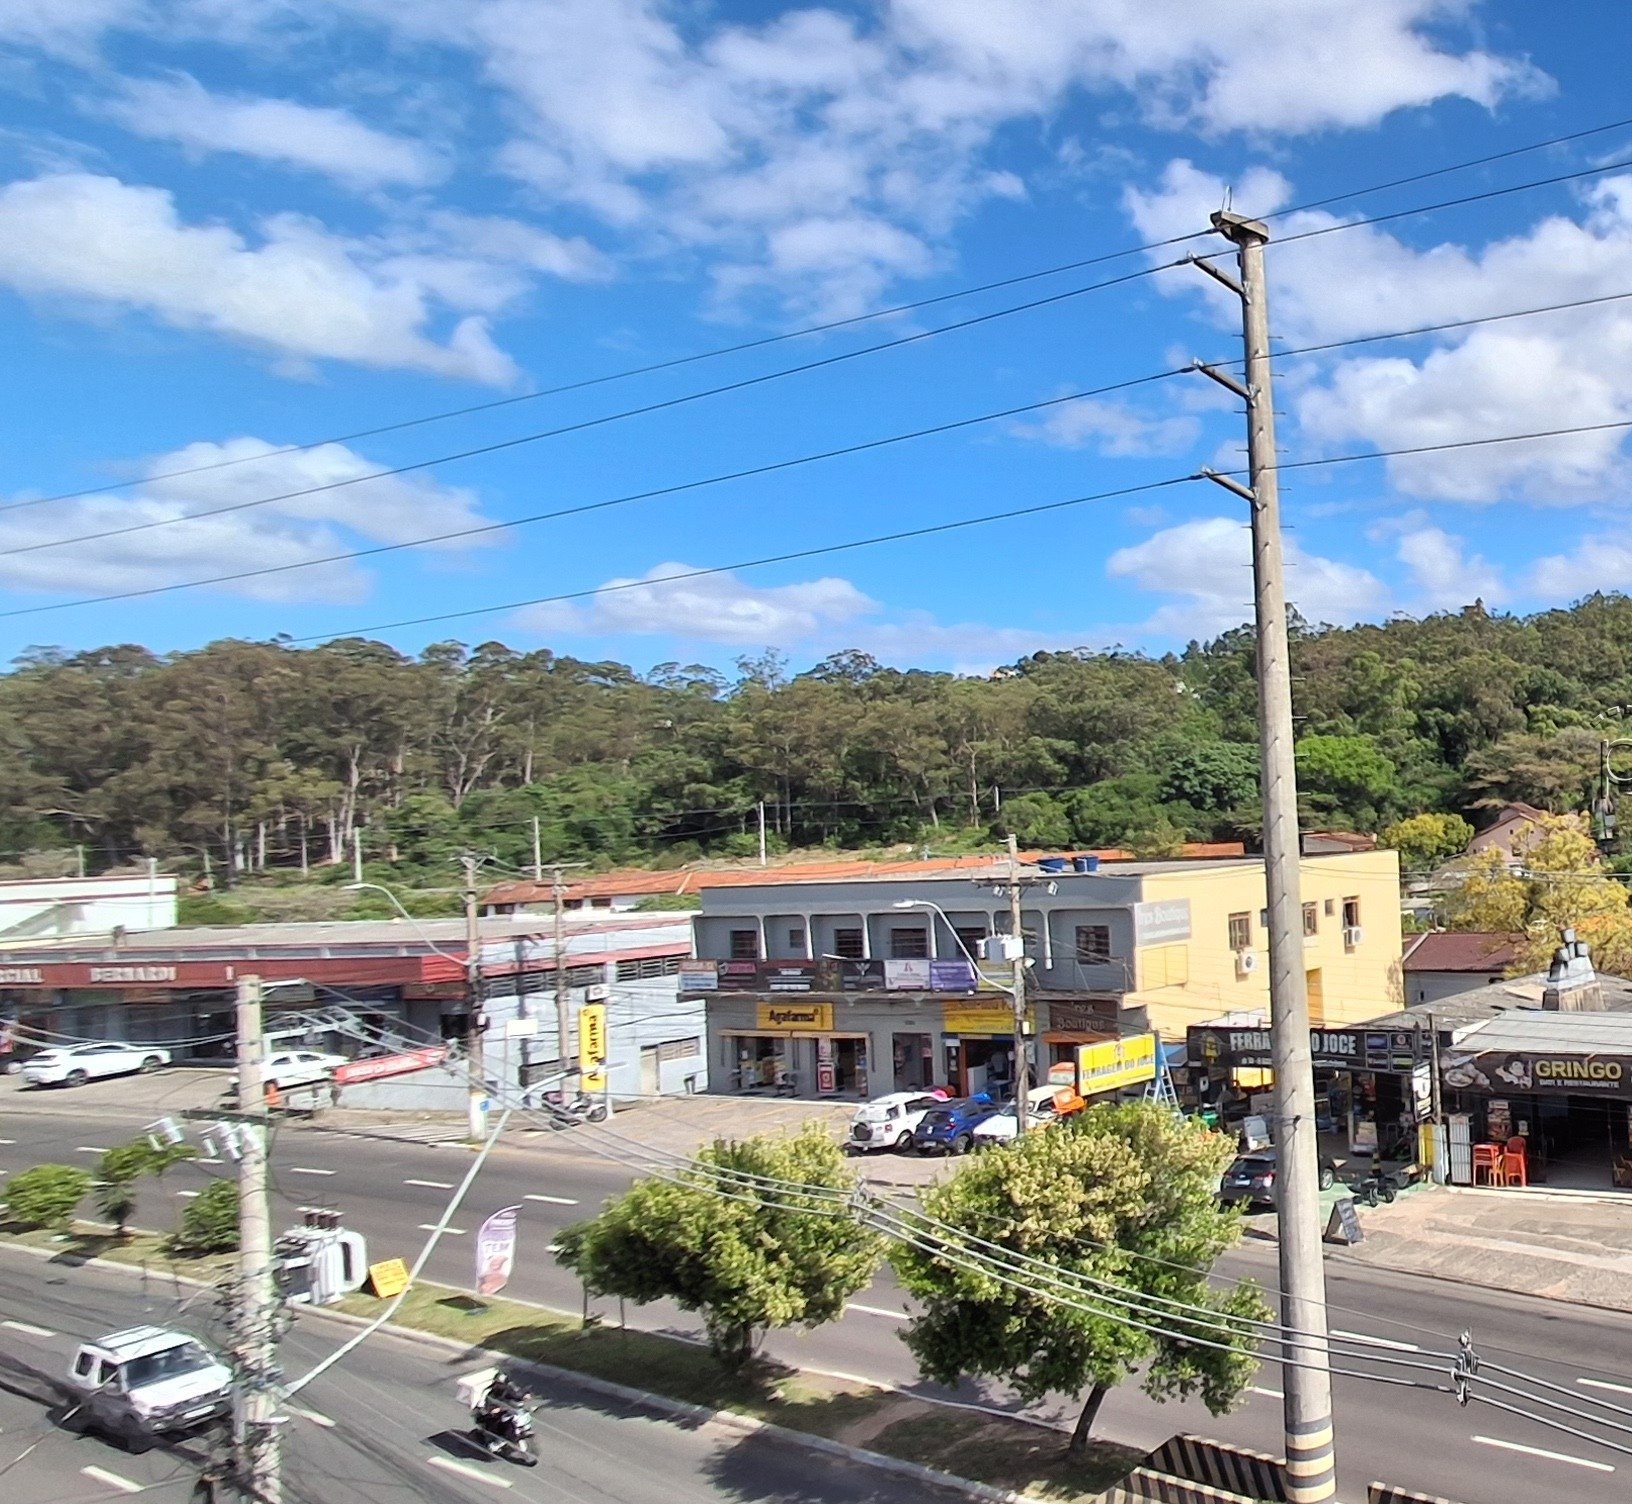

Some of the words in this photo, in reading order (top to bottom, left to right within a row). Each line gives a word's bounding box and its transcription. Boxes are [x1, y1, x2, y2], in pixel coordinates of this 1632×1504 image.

[90, 966, 178, 982] BERNARDI
[769, 1009, 815, 1025] Agafarma
[1323, 1033, 1357, 1055] JOCE
[1534, 1059, 1623, 1080] GRINGO
